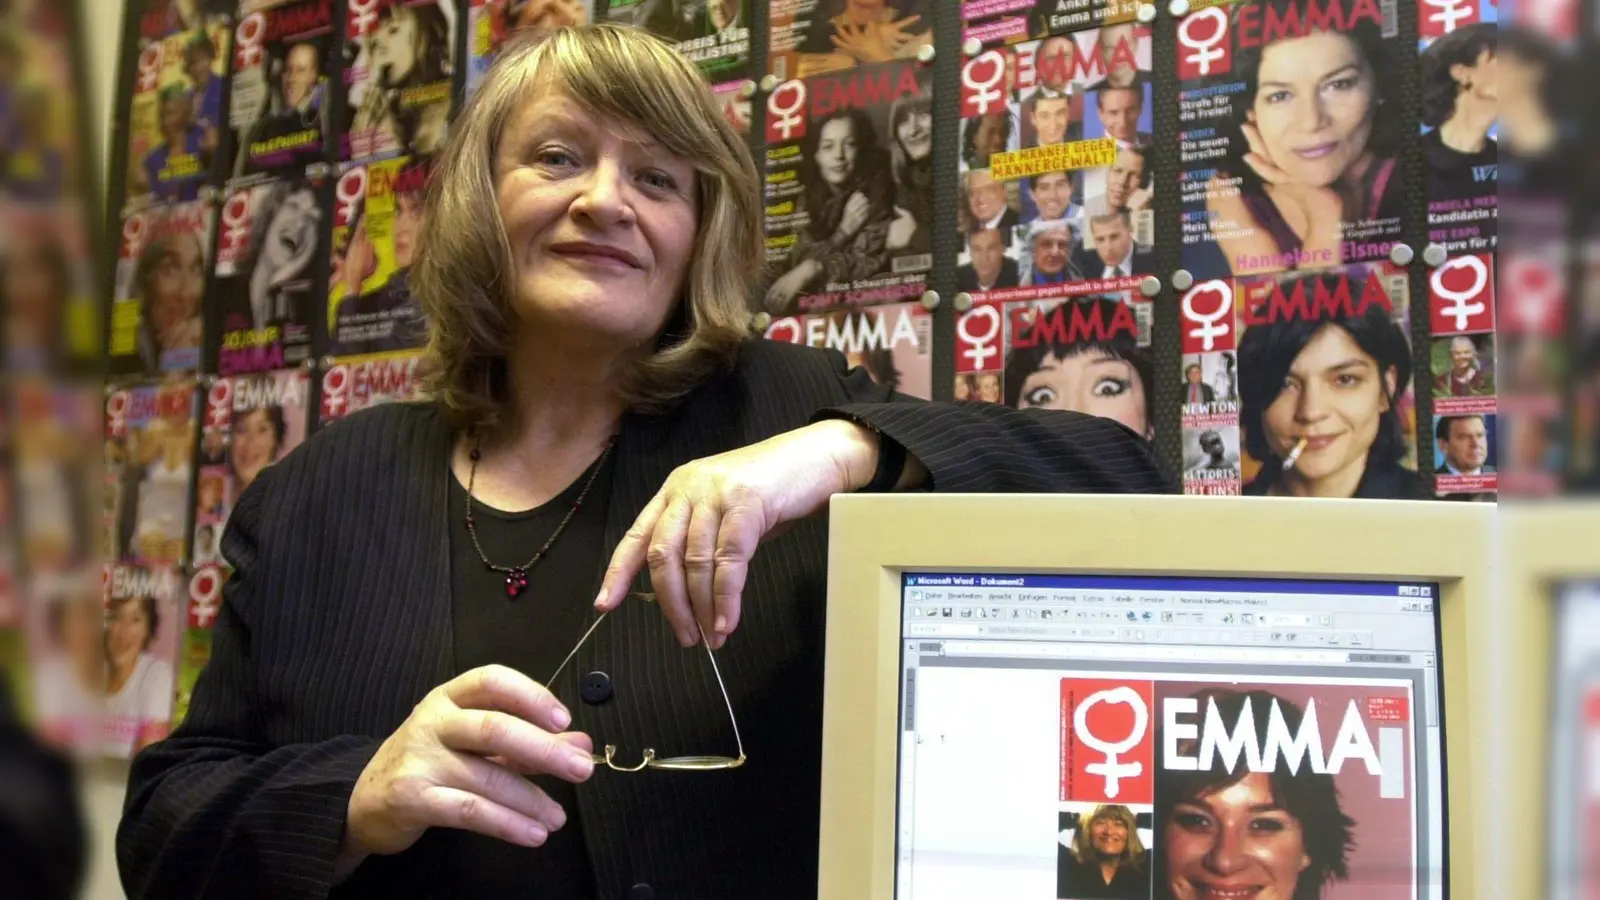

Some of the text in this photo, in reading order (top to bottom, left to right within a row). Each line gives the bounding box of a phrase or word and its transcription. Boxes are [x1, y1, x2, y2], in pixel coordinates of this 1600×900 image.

[1050, 12, 1090, 29] Emma
[1092, 4, 1119, 19] und
[1238, 0, 1383, 48] EMMA
[1016, 35, 1138, 90] EMMA
[812, 64, 920, 116] EMMA
[1180, 94, 1230, 111] Strafe für
[1180, 109, 1196, 121] die
[993, 152, 1016, 165] WIR
[1074, 139, 1114, 153] GEGEN
[1181, 136, 1230, 151] Die neuen
[1181, 148, 1228, 162] Burschen
[1182, 190, 1214, 202] wehren
[1182, 220, 1208, 233] Mein
[1428, 208, 1489, 225] Kandidatin
[1182, 232, 1201, 244] der
[1469, 237, 1488, 248] für
[1235, 245, 1332, 270] Hannelore
[1038, 285, 1063, 298] gegen
[1103, 280, 1117, 290] der
[1244, 269, 1393, 325] EMMA
[807, 309, 920, 354] EMMA
[1011, 297, 1140, 348] EMMA
[234, 372, 302, 412] EMMA
[1181, 400, 1238, 415] NEWTON
[112, 568, 175, 599] EMMA
[918, 577, 952, 585] Microsoft
[953, 578, 974, 586] Word
[981, 578, 1025, 587] Dokument2
[1163, 695, 1383, 777] EMMA
